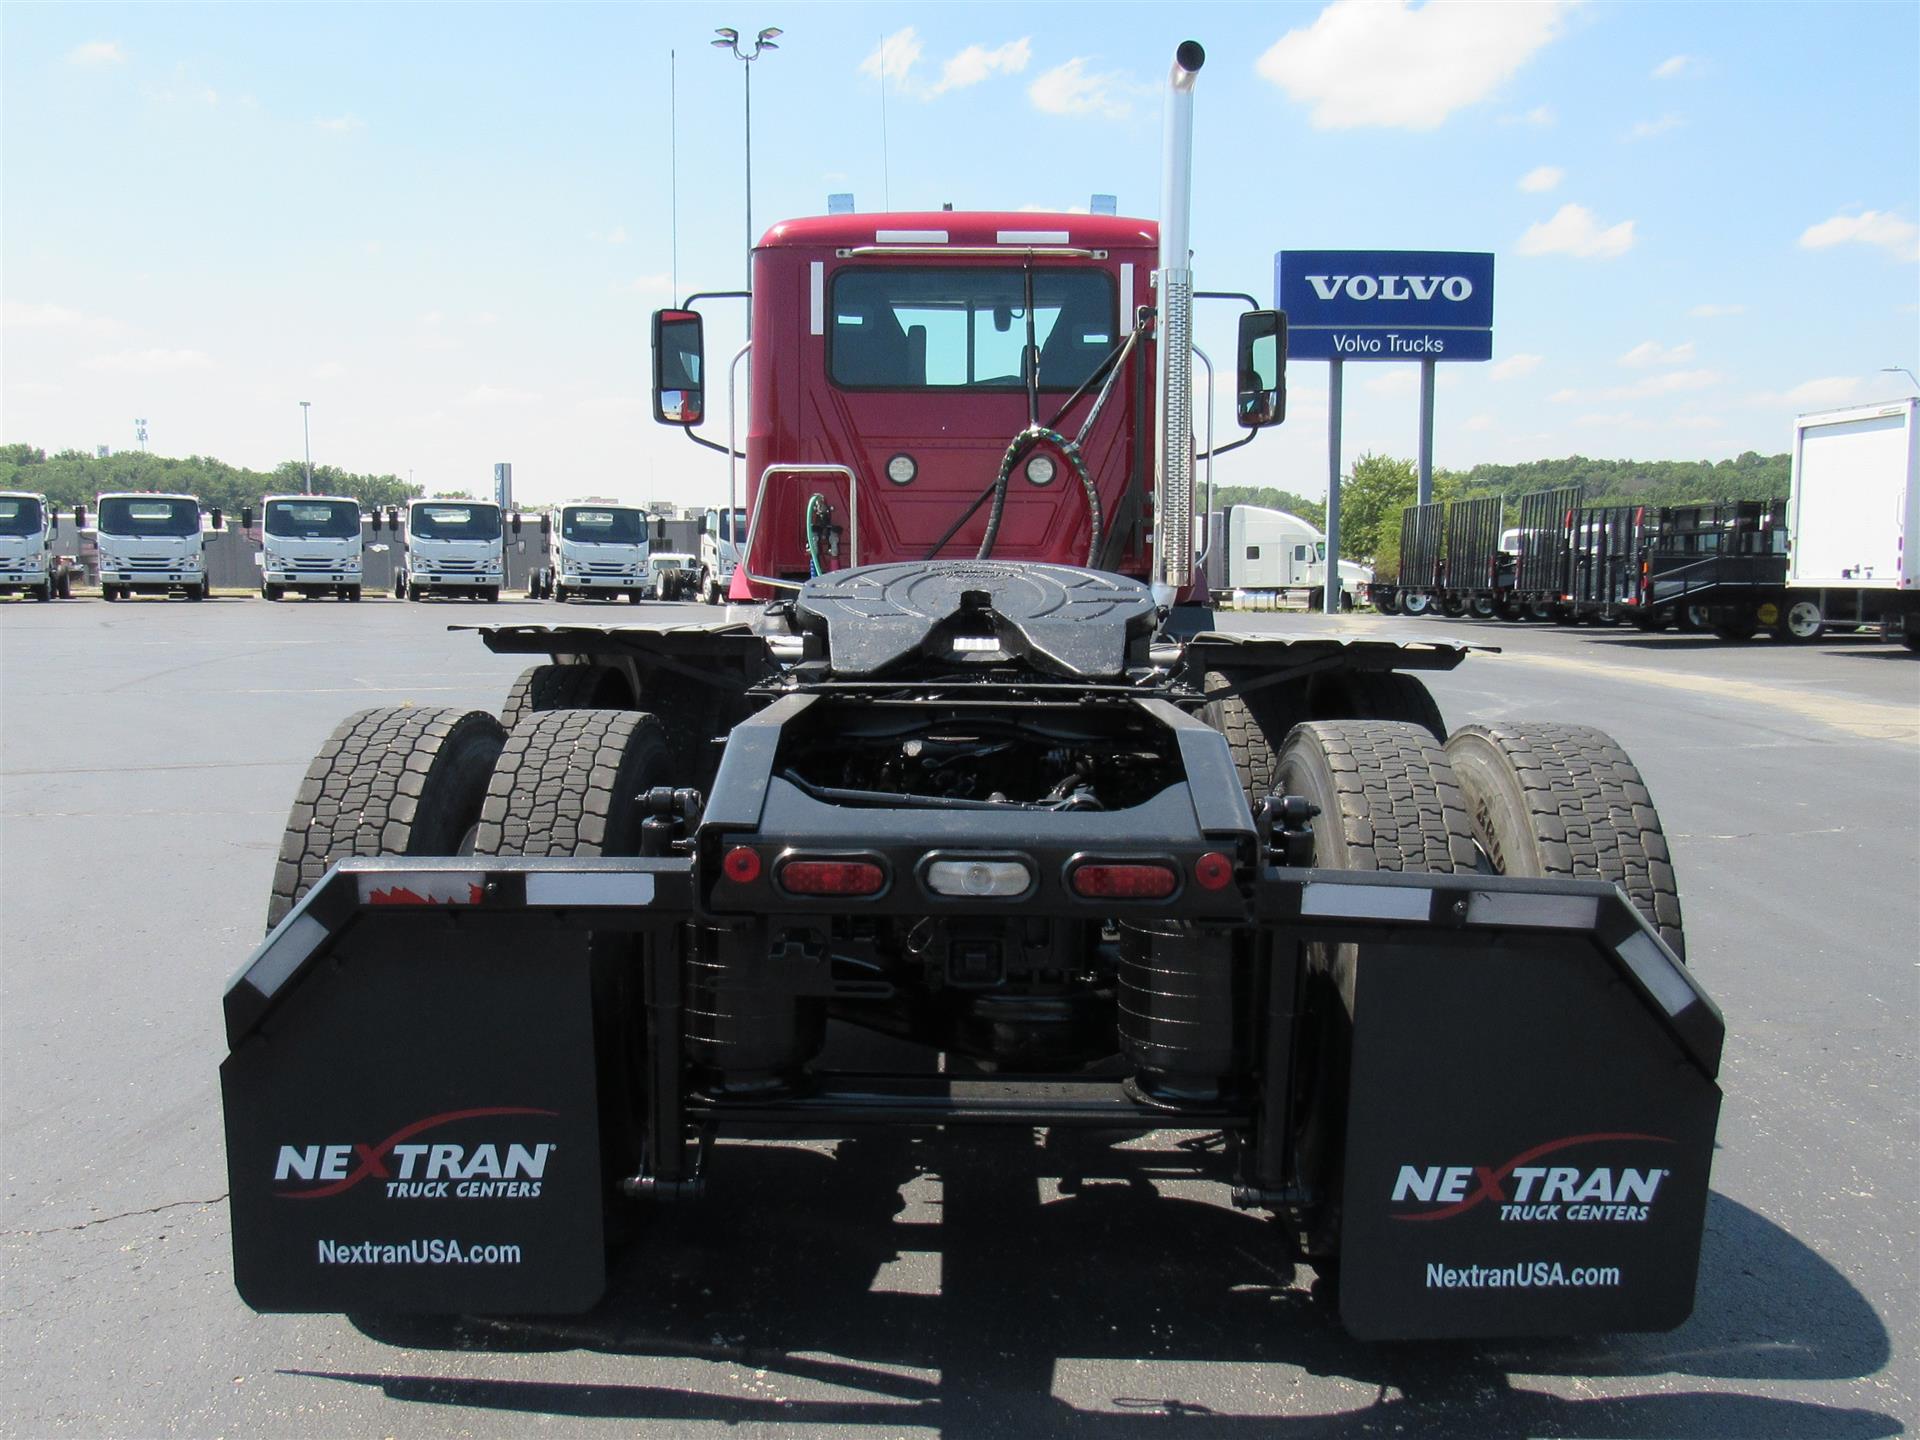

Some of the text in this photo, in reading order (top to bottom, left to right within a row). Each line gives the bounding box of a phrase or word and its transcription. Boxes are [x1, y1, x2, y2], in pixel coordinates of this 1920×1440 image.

[1305, 275, 1473, 301] VOLVO
[1332, 334, 1444, 353] Volvo Trucks
[274, 1143, 549, 1180] NEXTRAN
[386, 1181, 542, 1199] TRUCK CENTERS
[1391, 1165, 1663, 1203] NEXTRAN
[1500, 1204, 1650, 1222] TRUCK CENTERS
[318, 1239, 521, 1265] NextranUSA.com
[1425, 1262, 1620, 1288] NextranUSA.com
